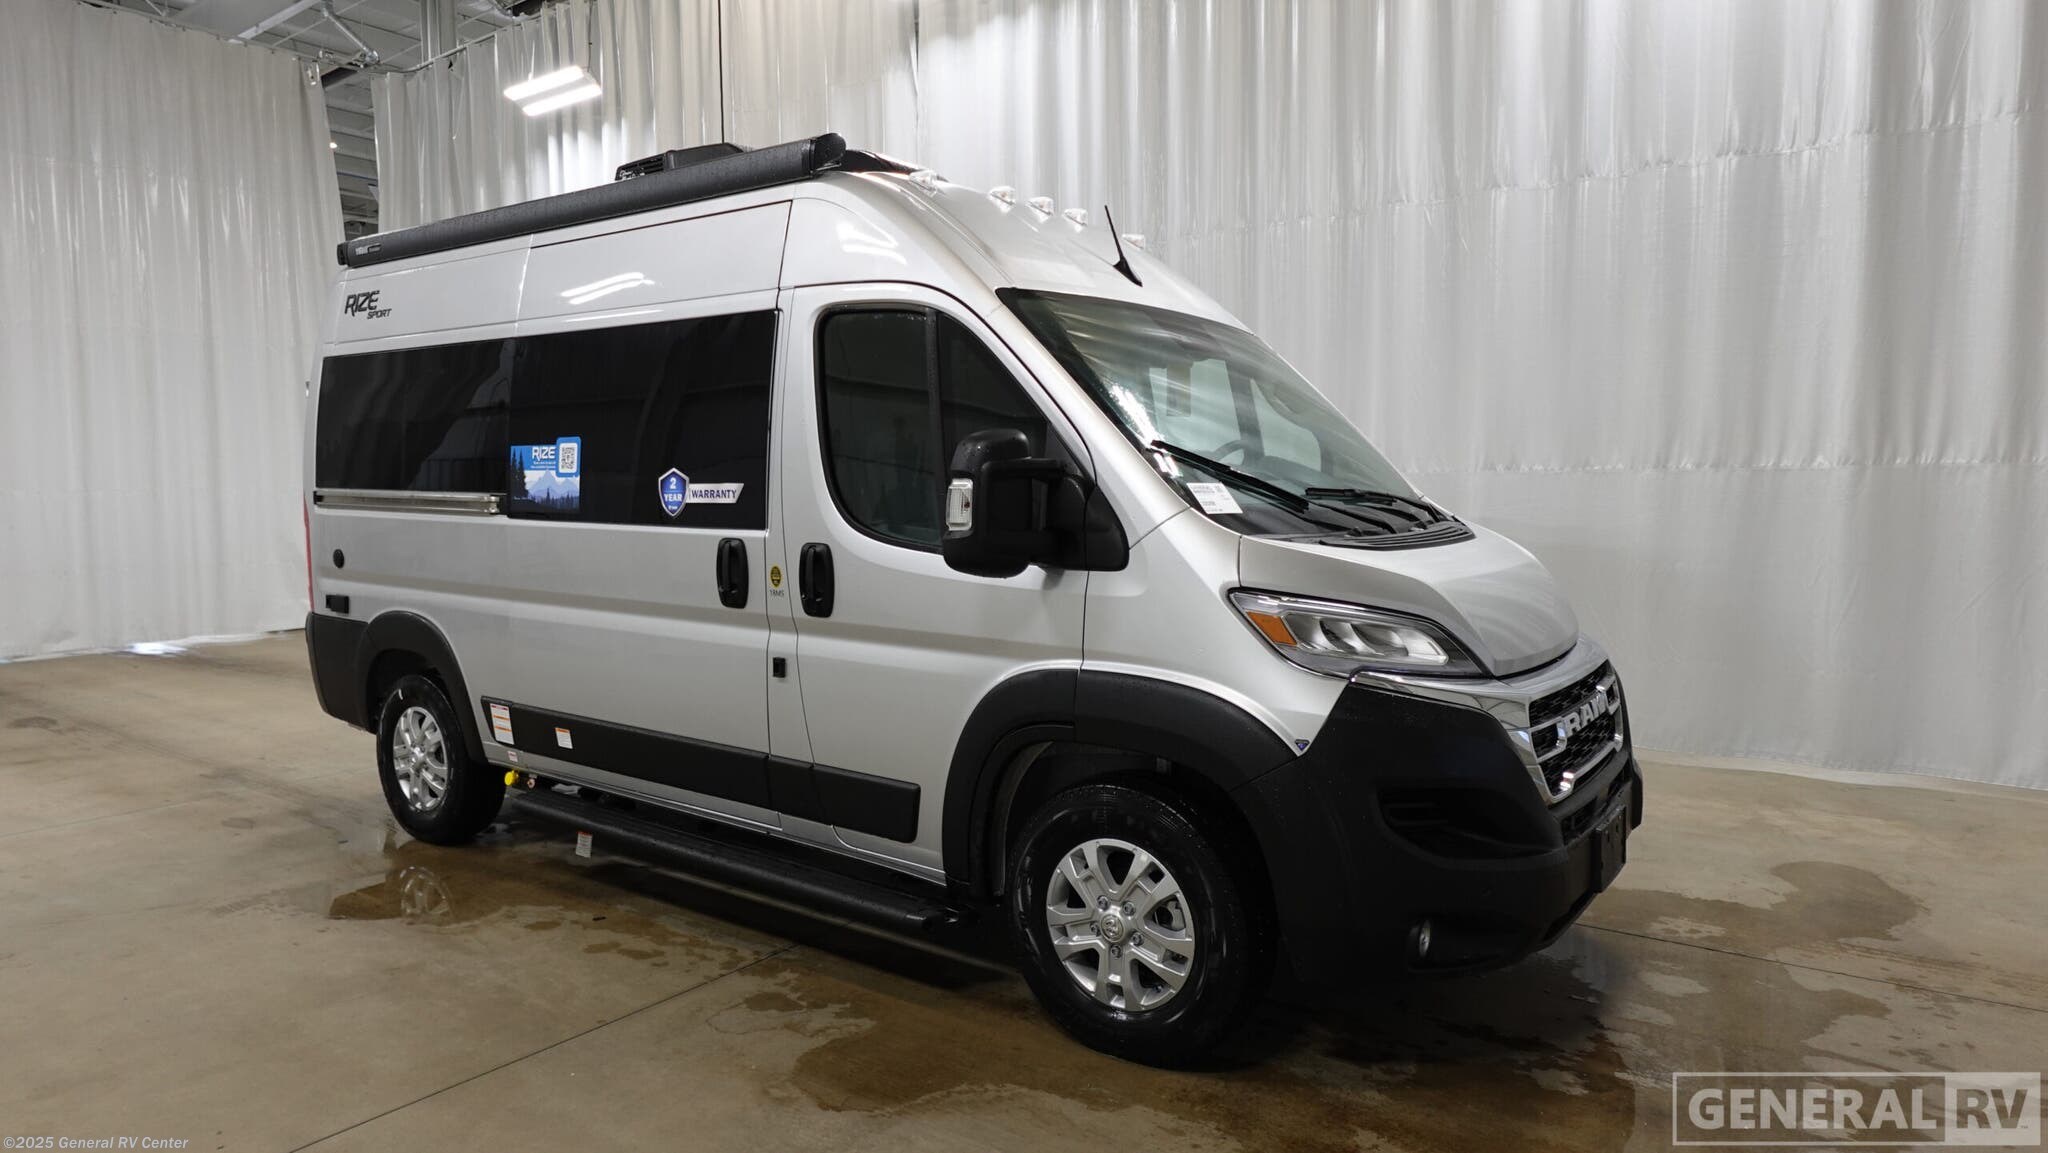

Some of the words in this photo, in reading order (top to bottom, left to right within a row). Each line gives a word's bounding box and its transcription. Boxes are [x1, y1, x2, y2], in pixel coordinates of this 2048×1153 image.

[344, 290, 381, 317] RIZE
[367, 308, 392, 320] SPORT
[532, 446, 556, 461] RIZE
[669, 477, 677, 489] 2
[664, 493, 683, 502] YEAR
[691, 489, 737, 499] WARRANTY
[1563, 691, 1607, 738] RAM
